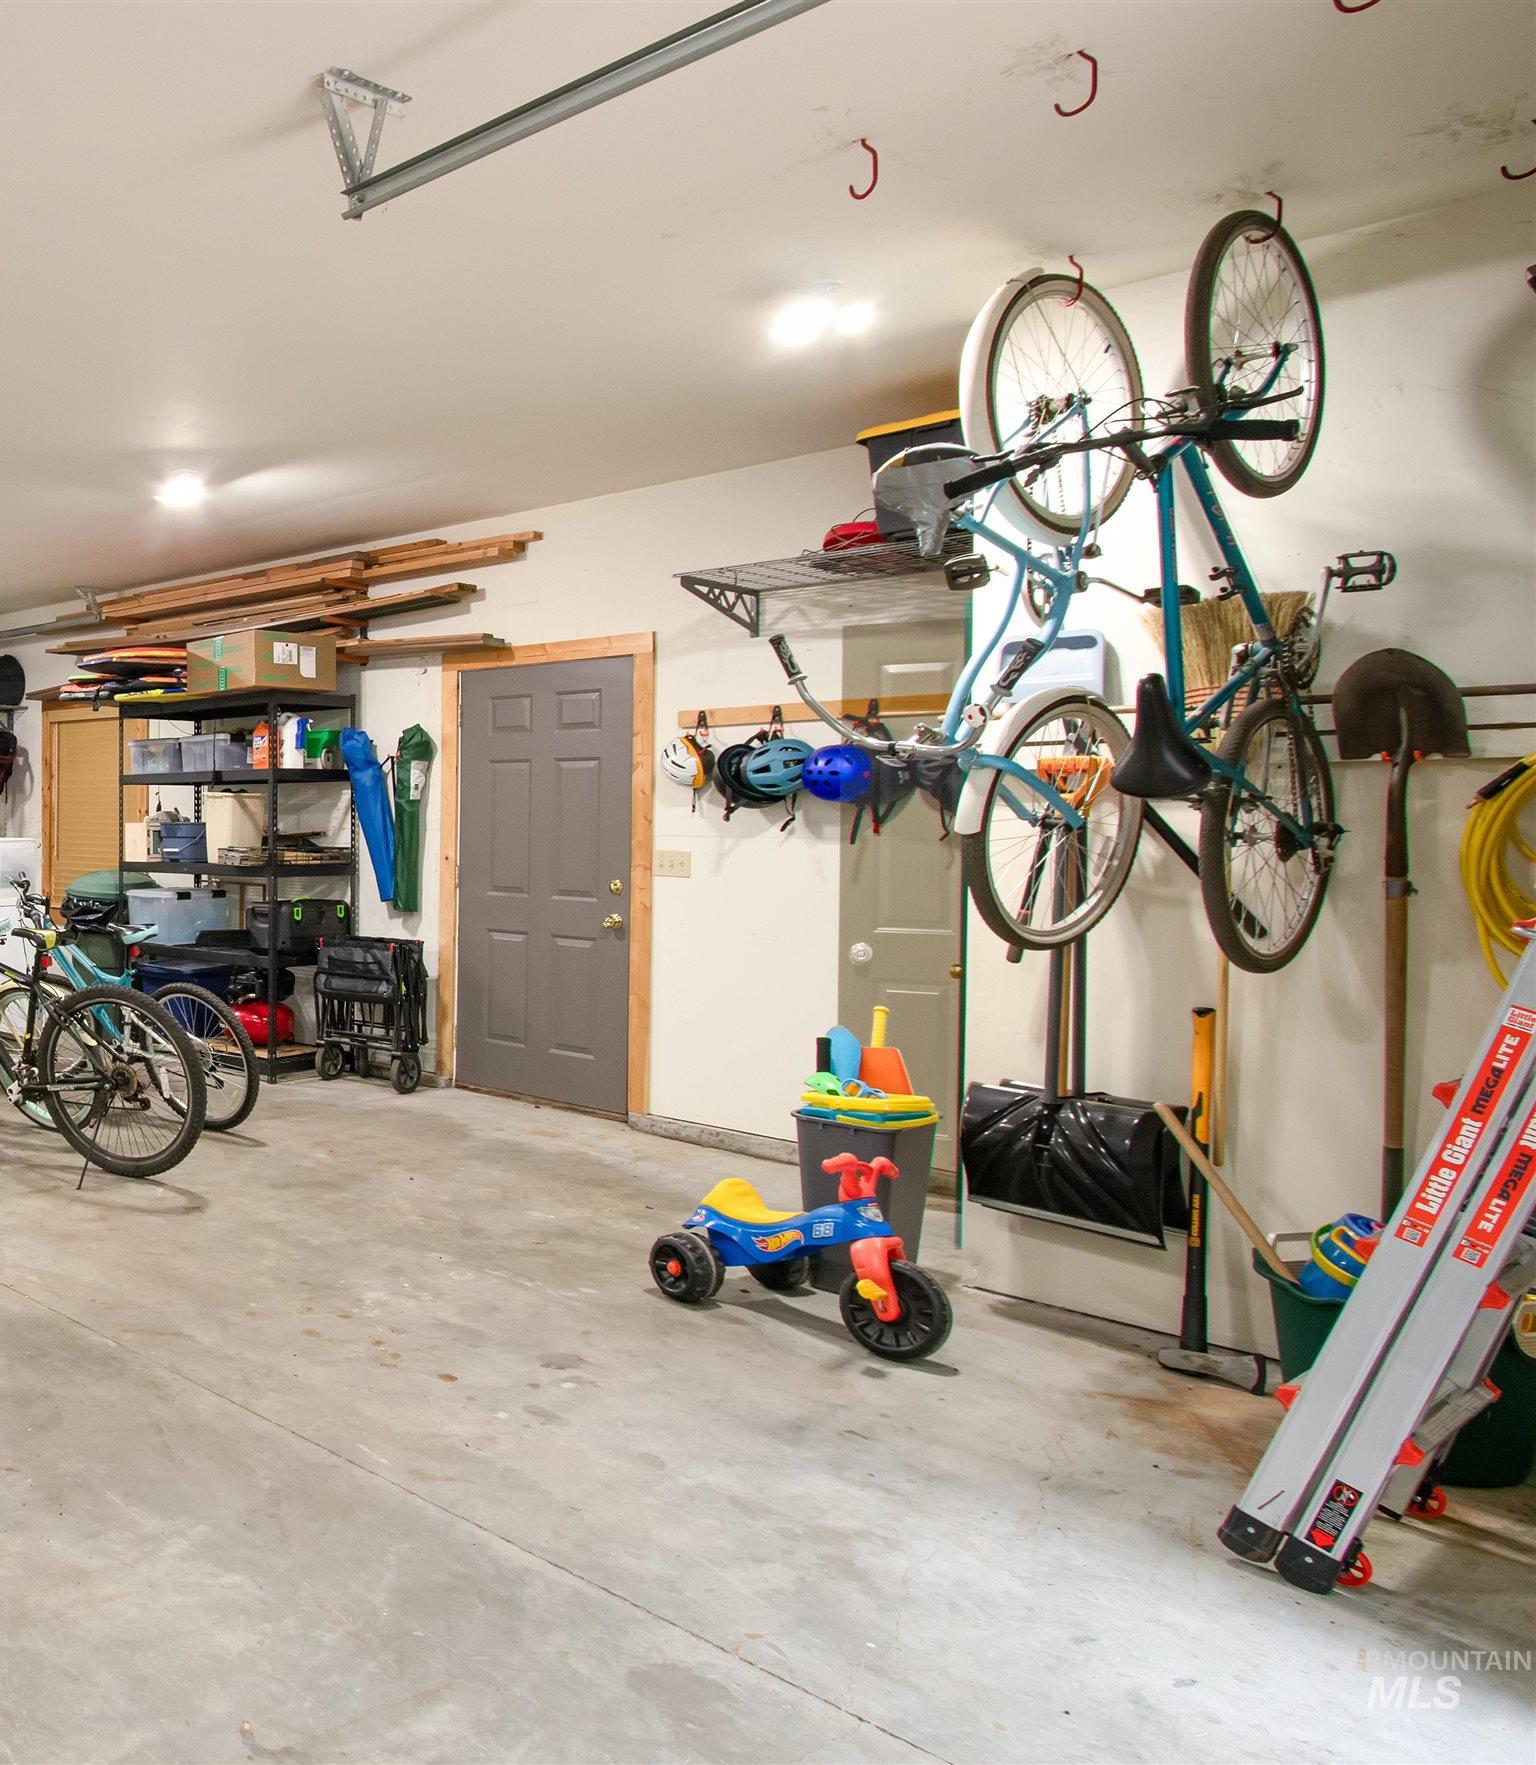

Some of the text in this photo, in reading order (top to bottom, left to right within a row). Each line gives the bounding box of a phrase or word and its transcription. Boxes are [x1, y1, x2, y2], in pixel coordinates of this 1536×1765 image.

[1415, 1167, 1457, 1216] Little
[1442, 1116, 1483, 1165] Giant
[812, 1222, 834, 1238] 68
